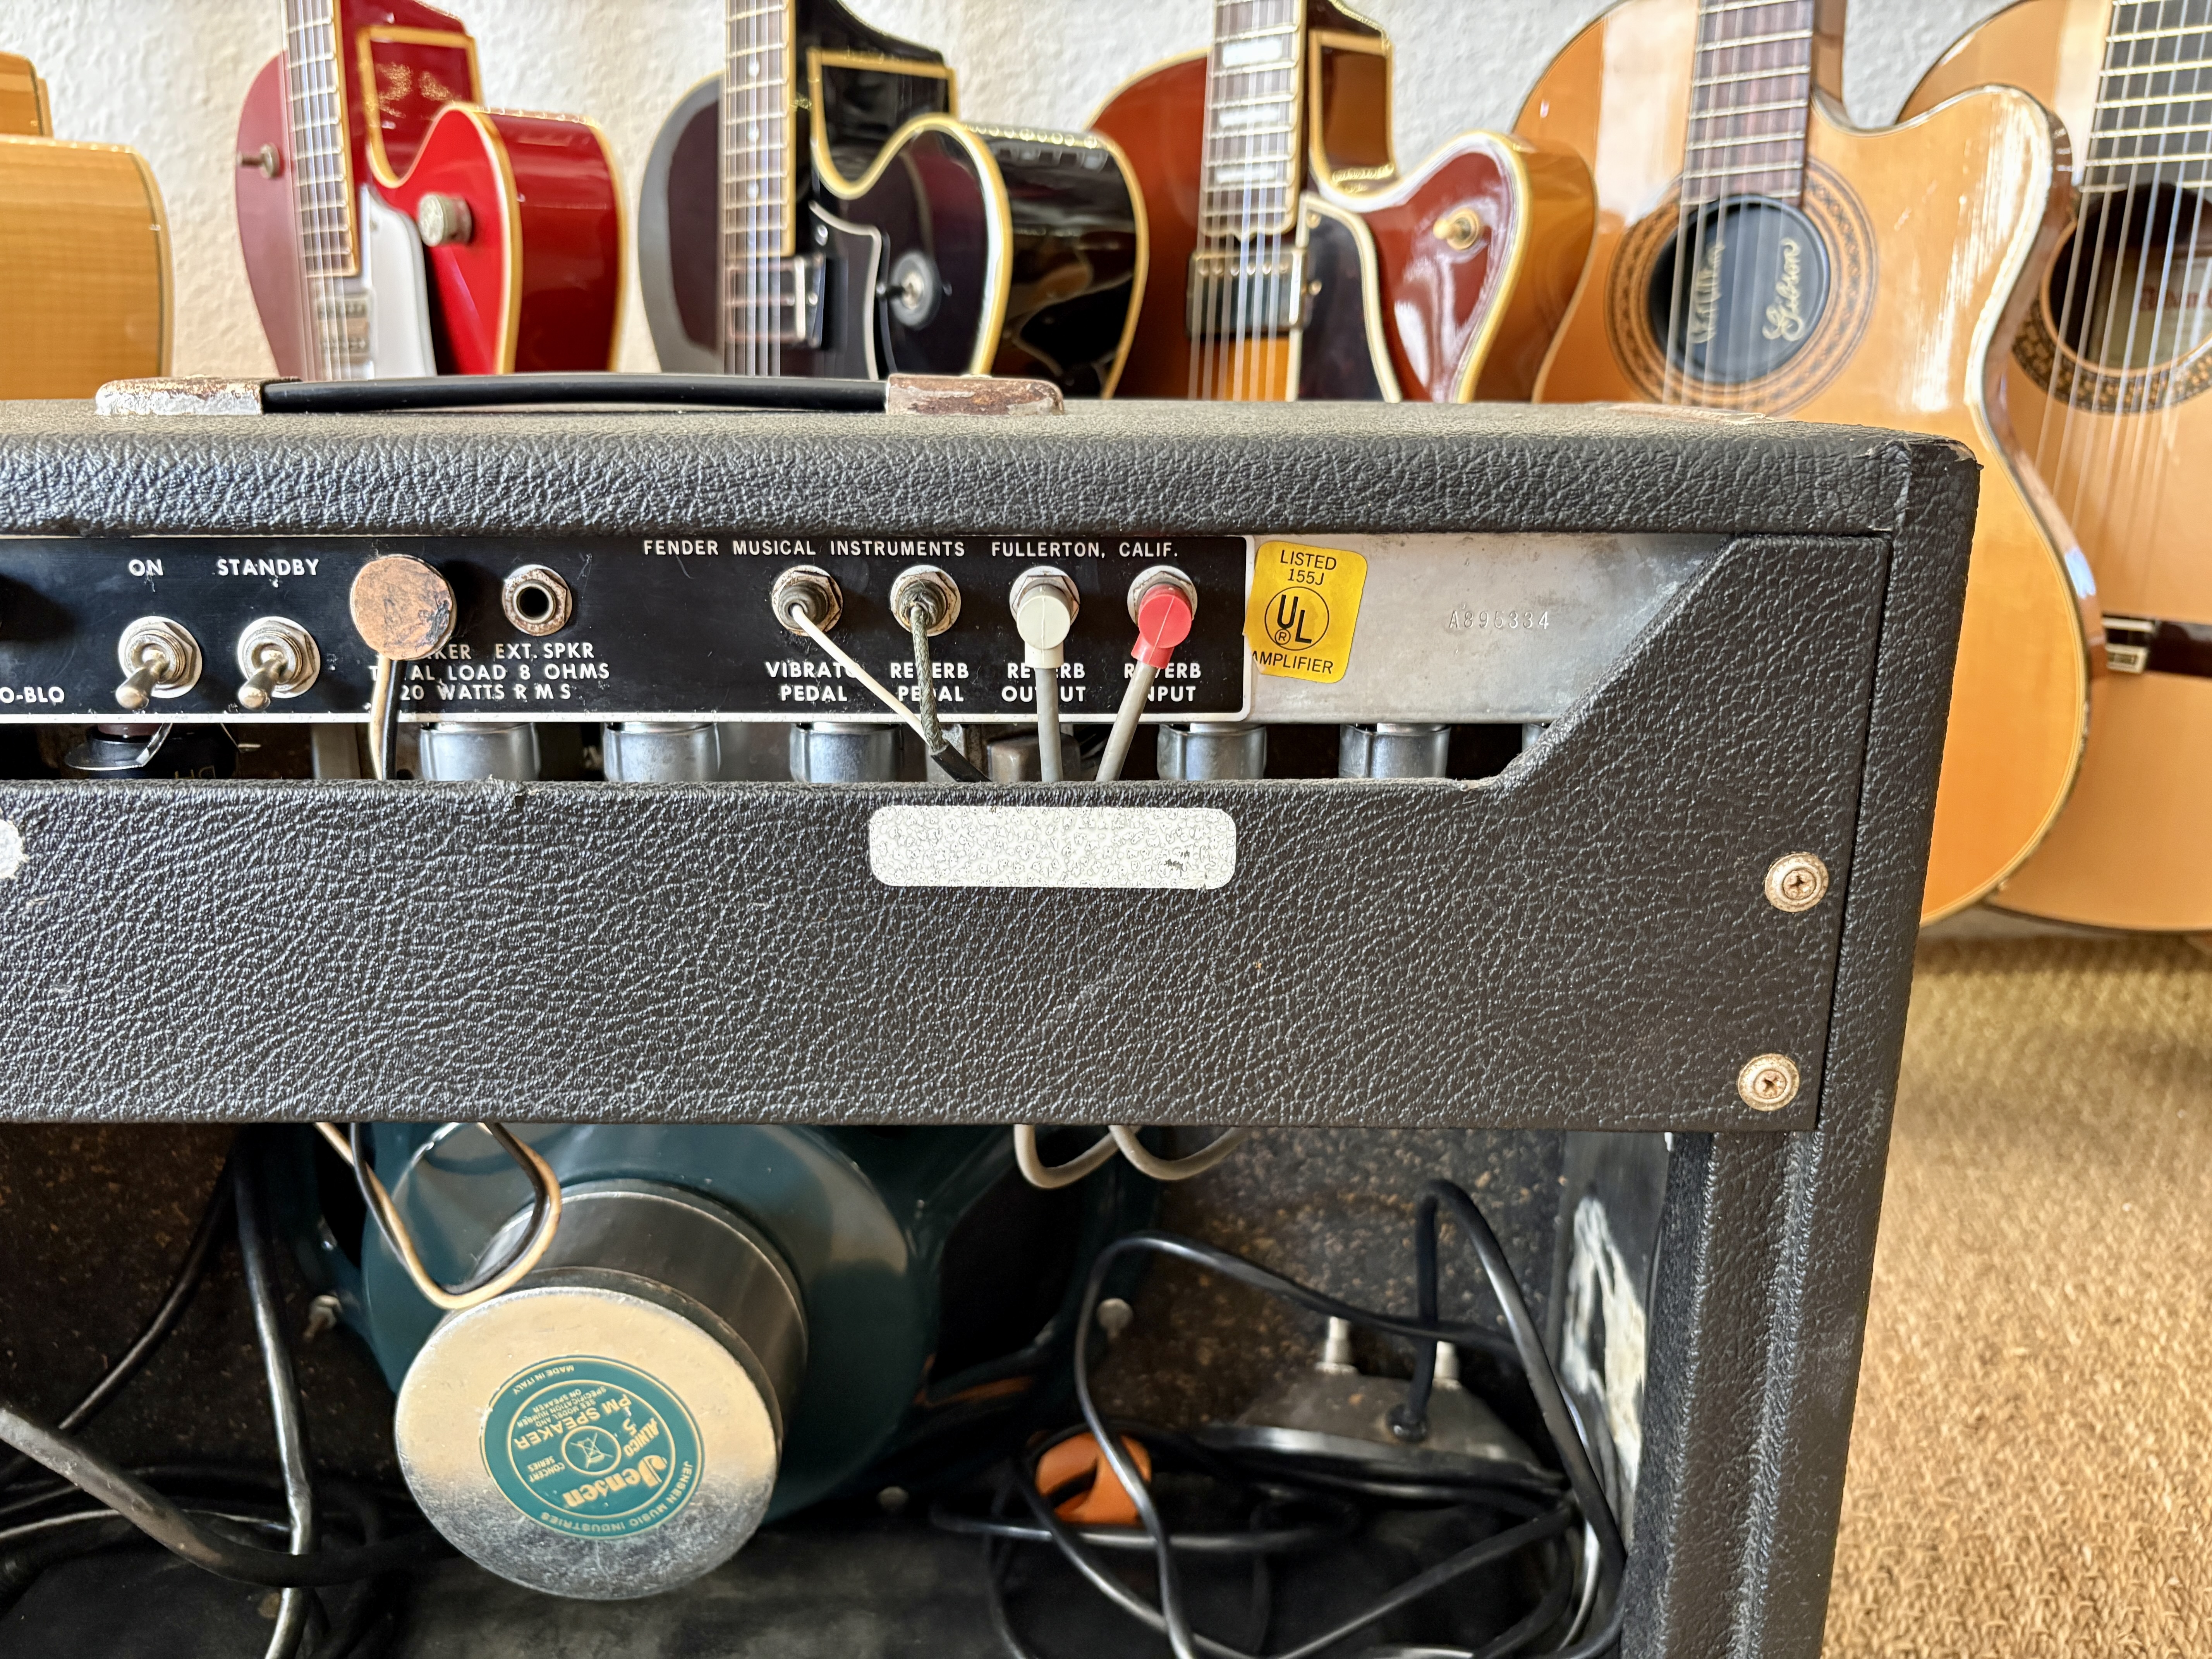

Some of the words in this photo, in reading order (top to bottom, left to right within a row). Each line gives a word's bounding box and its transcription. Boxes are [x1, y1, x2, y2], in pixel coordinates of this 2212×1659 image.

[644, 540, 718, 555] FENDER
[733, 540, 816, 556] MUSICAL
[831, 541, 964, 556] INSTRUMENTS
[992, 542, 1105, 558] FULLERTON,
[1119, 542, 1178, 557] CALIF.
[129, 559, 163, 576] ON
[216, 559, 319, 576] STANDBY
[1280, 550, 1336, 570] LISTED
[1287, 568, 1324, 585] 155J
[1277, 594, 1312, 644] UL
[495, 643, 538, 659] EXT.
[544, 642, 594, 659] SPKR
[891, 663, 969, 679] REERB
[1008, 663, 1085, 679] RERB
[1124, 663, 1201, 679] RERB
[1252, 651, 1333, 674] AMPLIFIER
[369, 665, 435, 681] TAL
[448, 664, 506, 681] LOAD
[520, 664, 531, 680] 8
[544, 663, 610, 680] OHMS
[437, 684, 505, 700] WATTS
[780, 686, 847, 702] PEDAL
[898, 686, 964, 702] PEAL
[1001, 686, 1085, 702] OUUT
[1147, 686, 1196, 702] NPUT
[534, 1372, 546, 1381] IN
[546, 1365, 575, 1376] MADE
[512, 1377, 535, 1395] ITALY
[569, 1389, 582, 1398] ON
[532, 1394, 569, 1413] SPEAKER
[550, 1386, 607, 1413] SPECIFICATION
[580, 1399, 596, 1409] SEE
[602, 1394, 632, 1414] PM
[517, 1410, 550, 1427] NUMBER
[552, 1406, 580, 1420] MODEL
[514, 1407, 601, 1449] SPEAKER
[536, 1417, 551, 1427] AND
[622, 1418, 637, 1436] 5
[623, 1418, 659, 1457] ALNICO
[527, 1456, 555, 1472] SERIES
[529, 1462, 565, 1483] CONCERT
[562, 1455, 668, 1507] Jensen
[665, 1461, 693, 1504] JENSEN
[541, 1512, 626, 1533] INDUSTRIES
